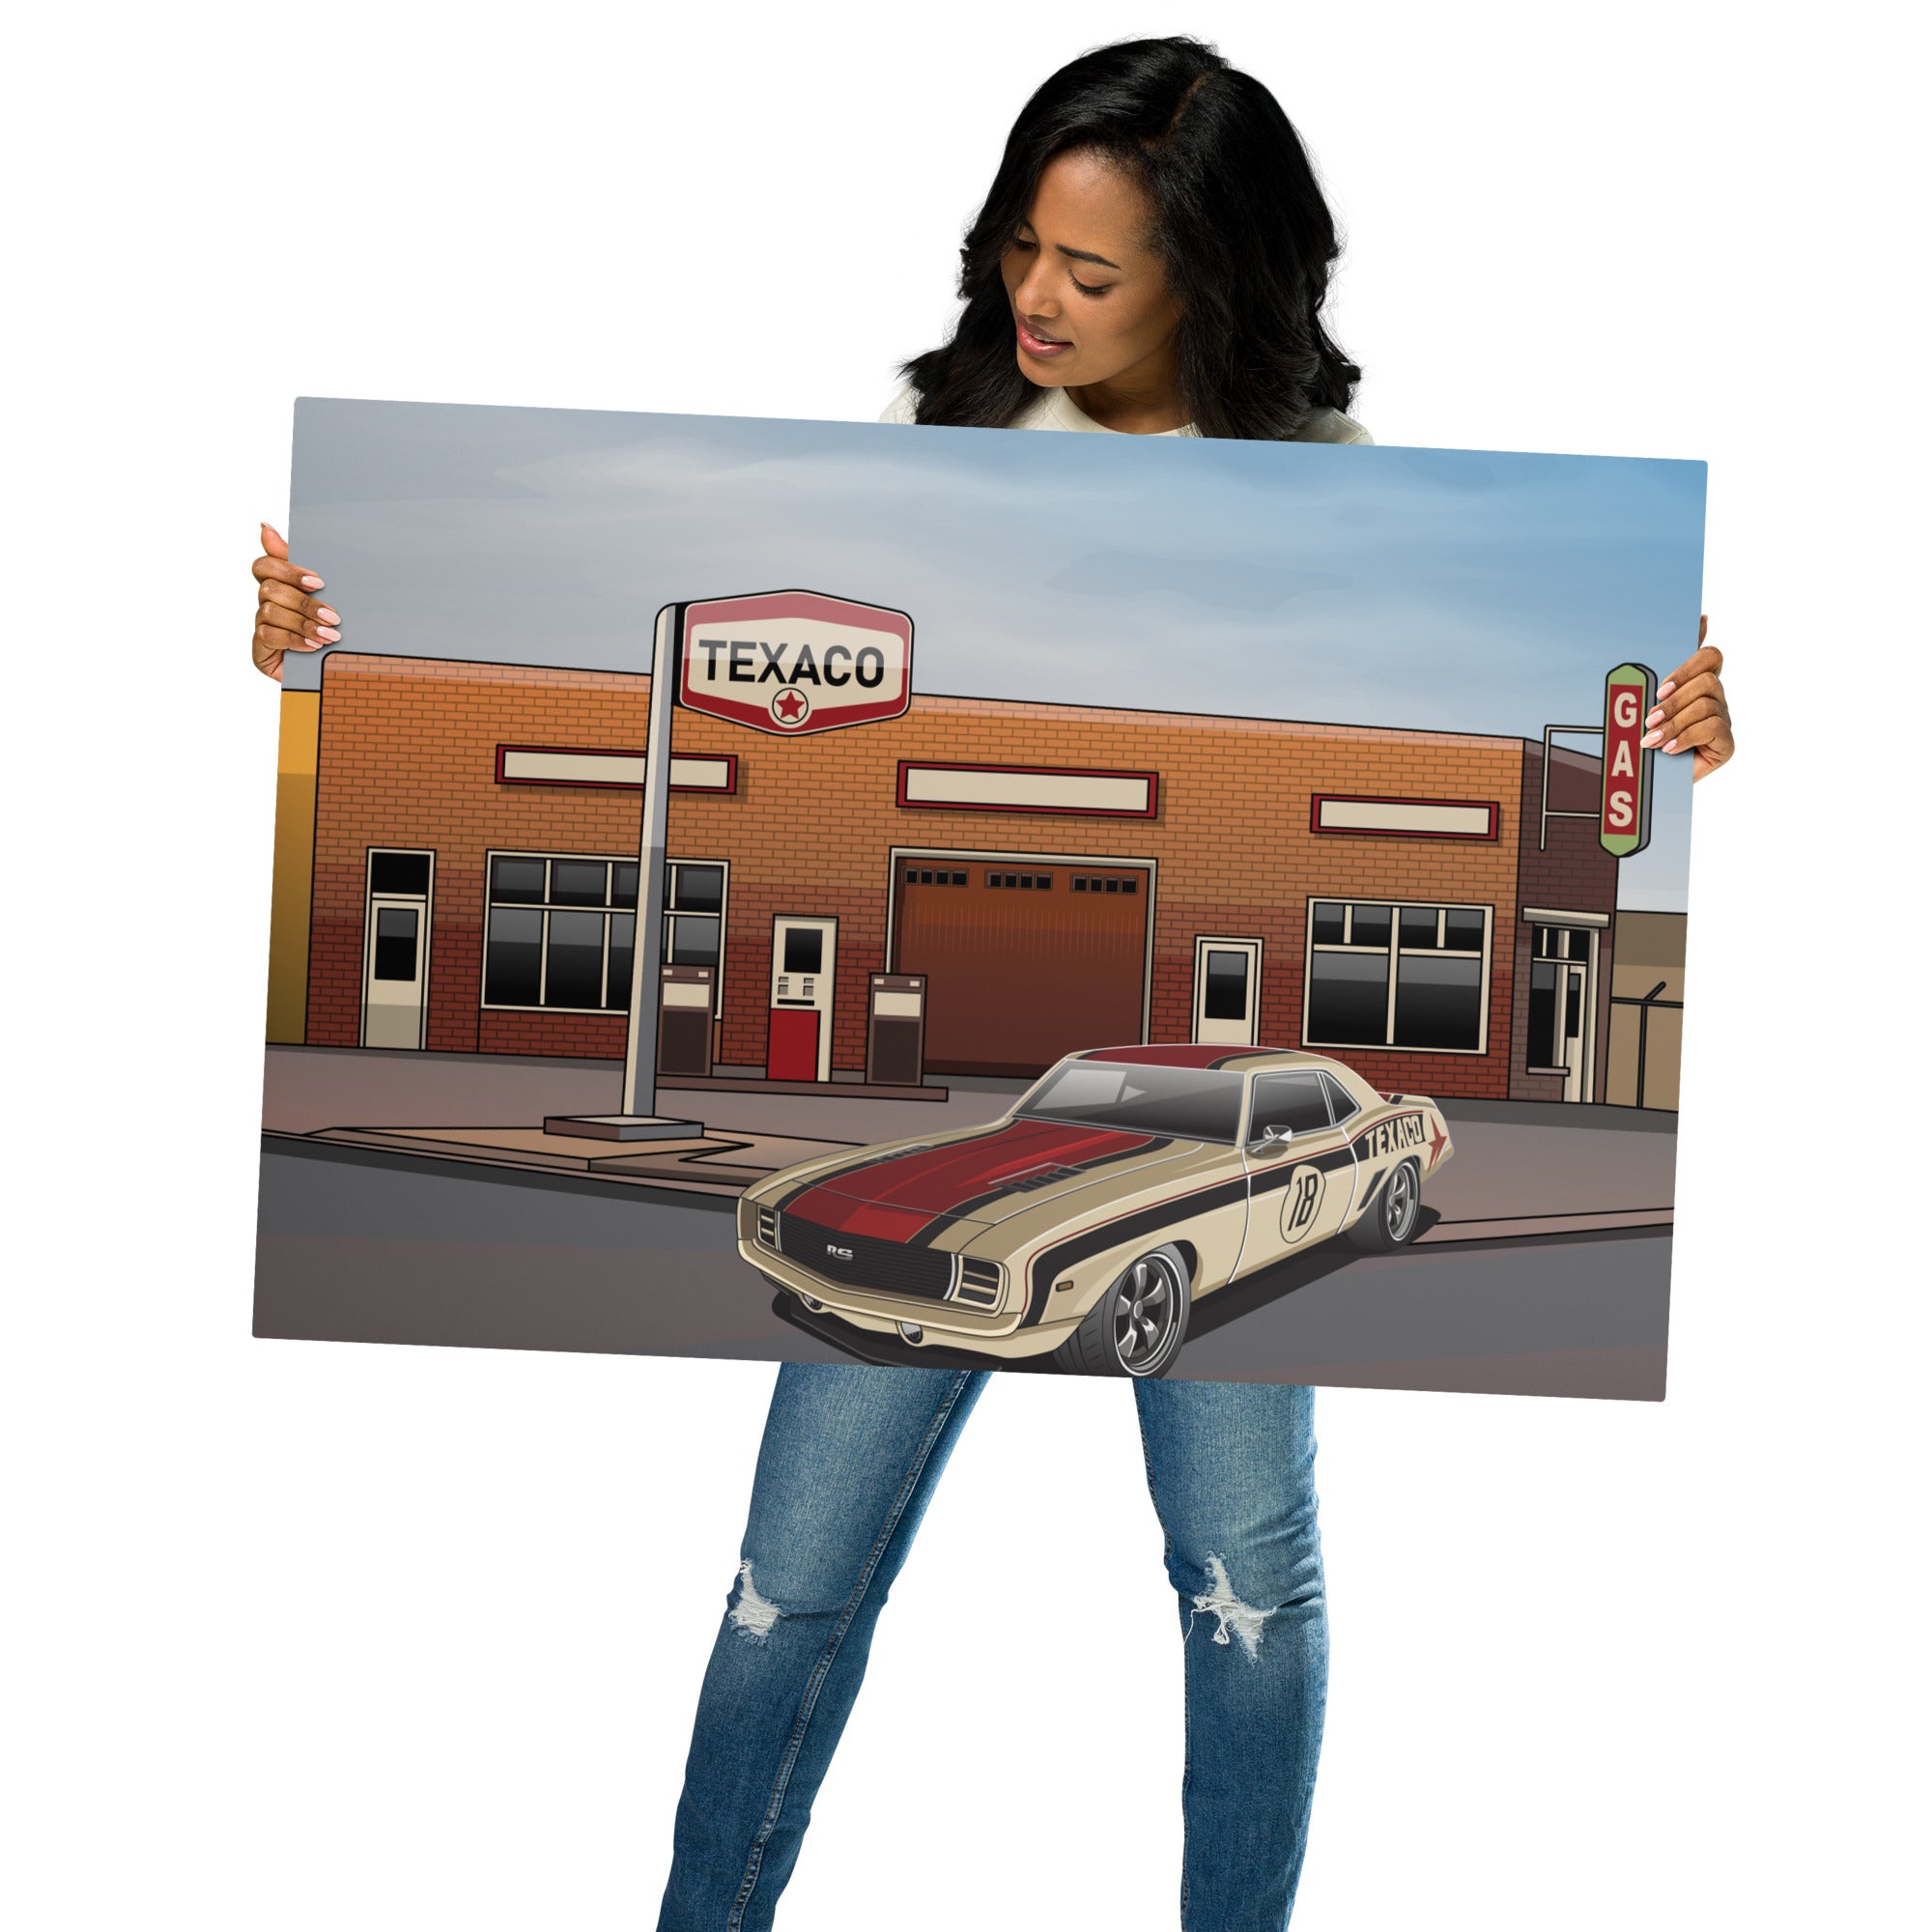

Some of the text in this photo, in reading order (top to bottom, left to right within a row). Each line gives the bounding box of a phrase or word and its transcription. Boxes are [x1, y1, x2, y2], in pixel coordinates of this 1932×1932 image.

[698, 639, 885, 688] TEXACO
[1608, 692, 1637, 827] GAS
[1365, 1115, 1424, 1158] TEXACO
[1288, 1174, 1319, 1232] 18
